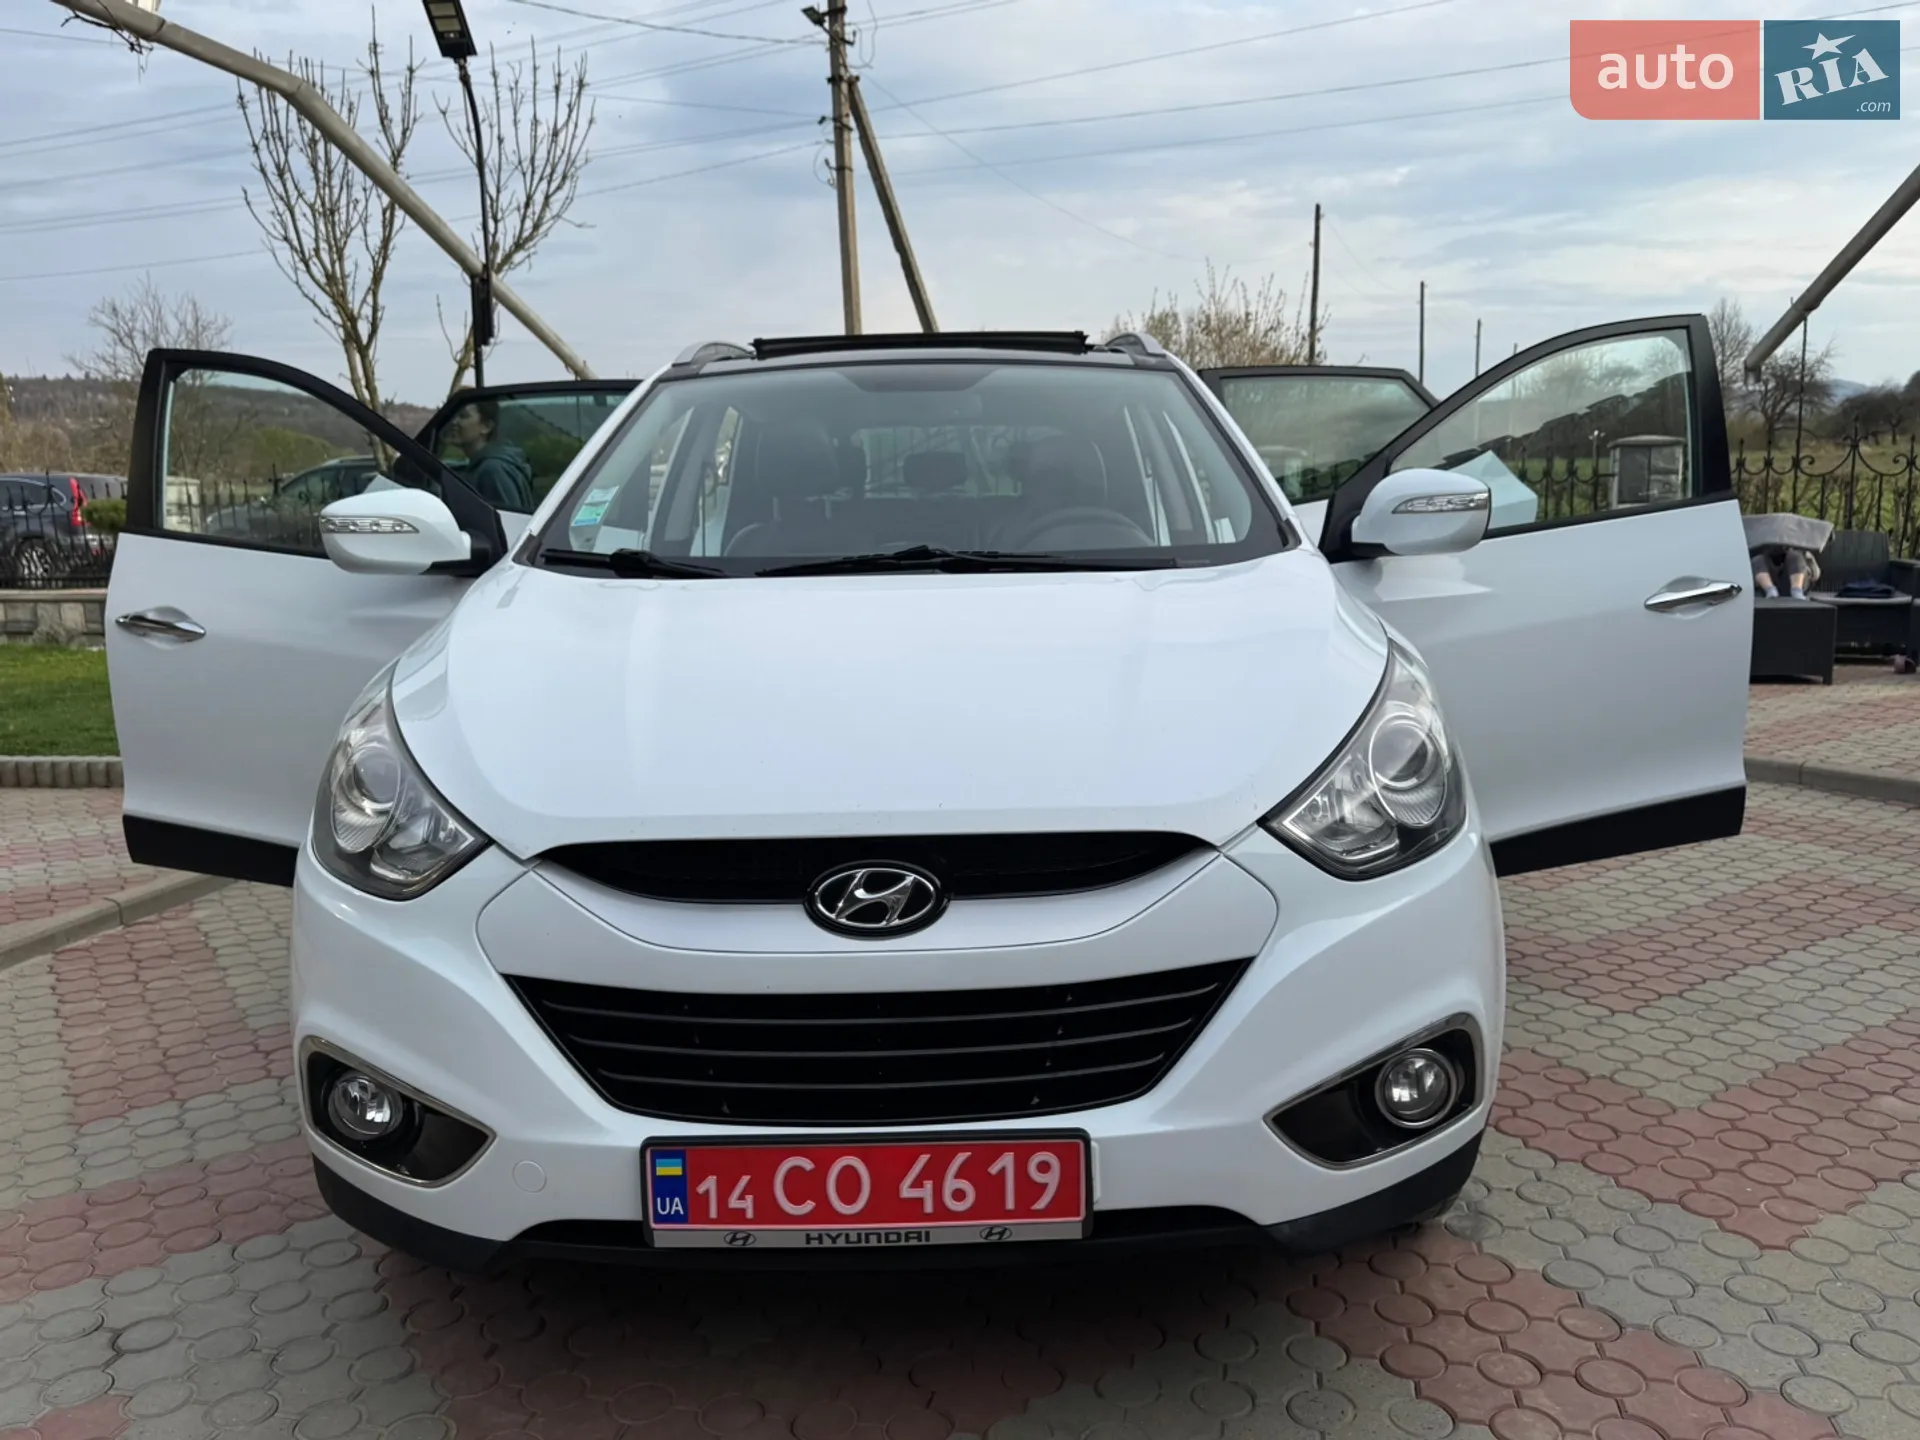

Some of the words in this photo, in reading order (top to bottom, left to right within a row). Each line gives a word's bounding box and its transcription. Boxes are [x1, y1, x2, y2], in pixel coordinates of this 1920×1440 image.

[695, 1174, 755, 1219] 14
[773, 1156, 871, 1215] CO
[899, 1151, 1061, 1214] 4619
[657, 1197, 684, 1215] UA
[805, 1230, 931, 1246] HYUNDAI
